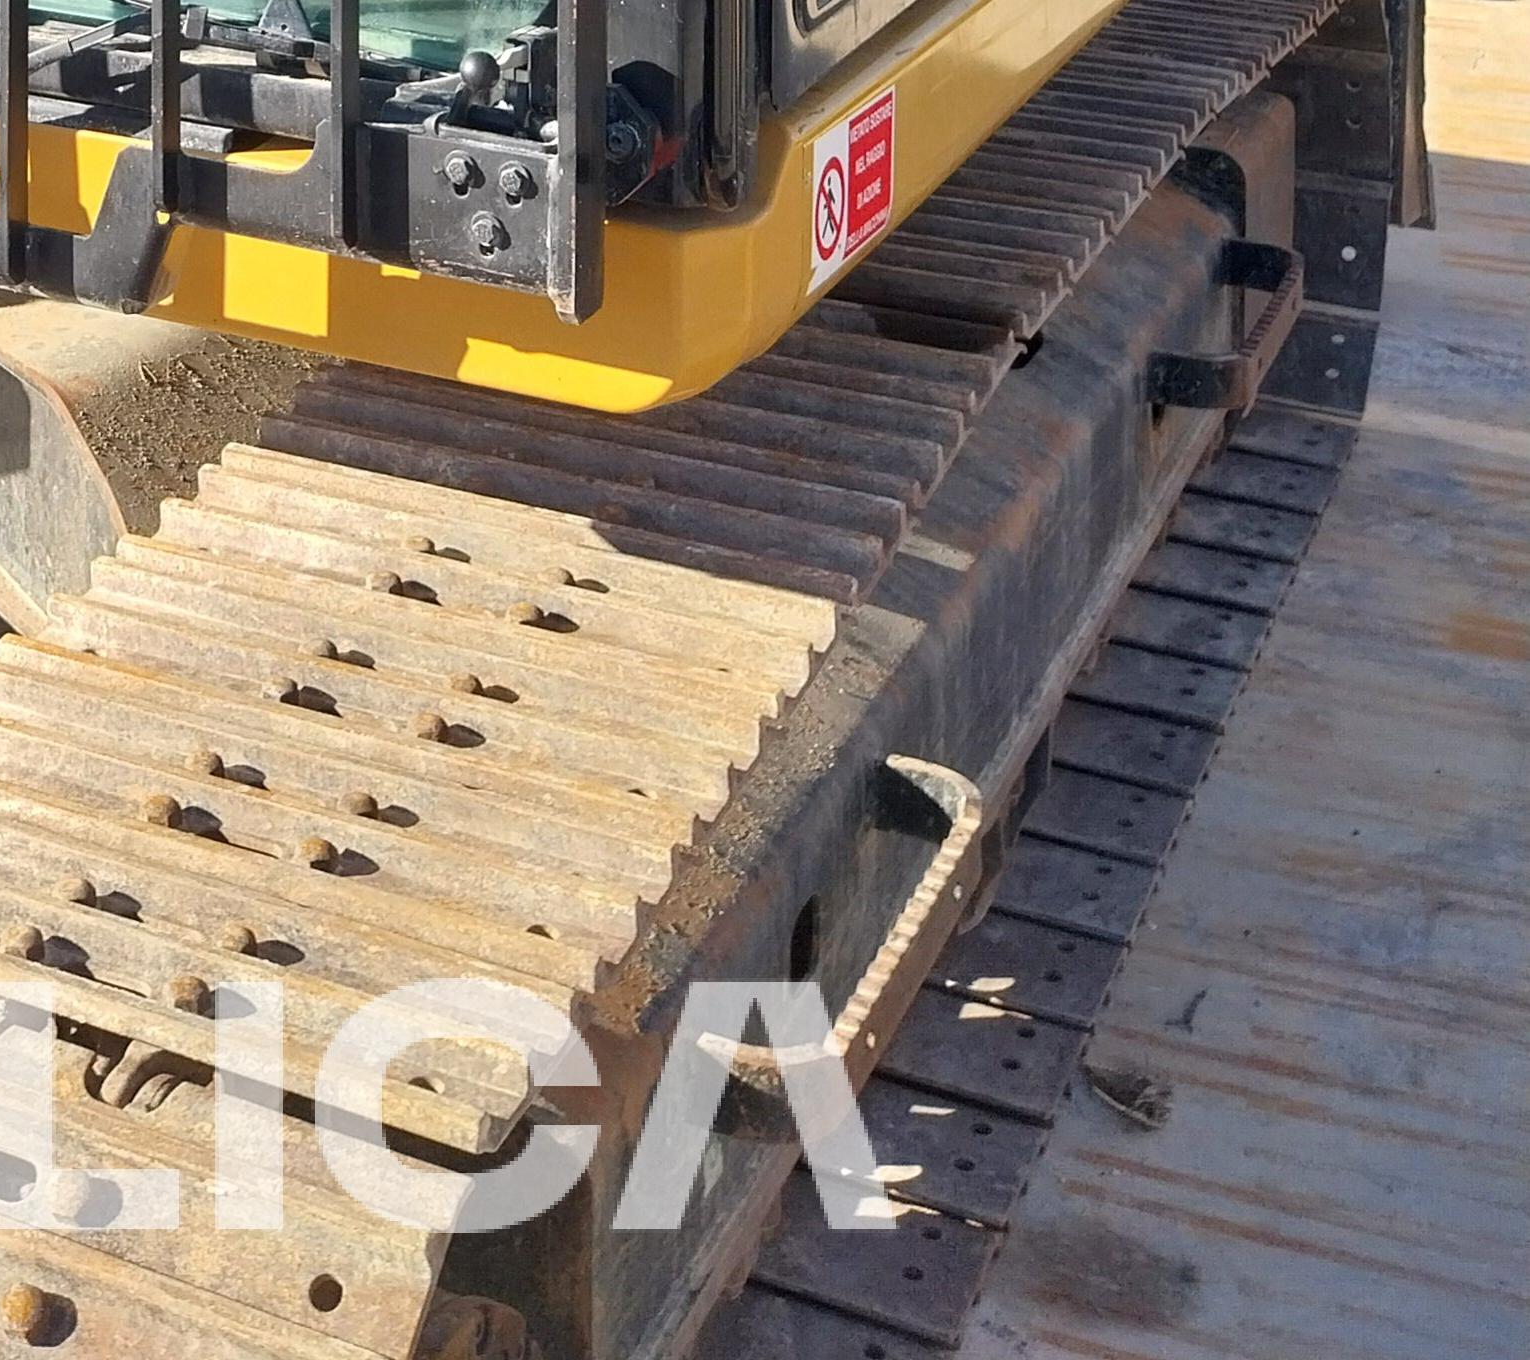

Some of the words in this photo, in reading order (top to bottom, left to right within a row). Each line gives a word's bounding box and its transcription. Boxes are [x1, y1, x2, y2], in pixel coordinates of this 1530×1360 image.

[850, 117, 870, 144] VIETATO
[855, 154, 866, 176] NEL
[866, 140, 886, 166] RAGGIO
[863, 177, 882, 203] AZIONE
